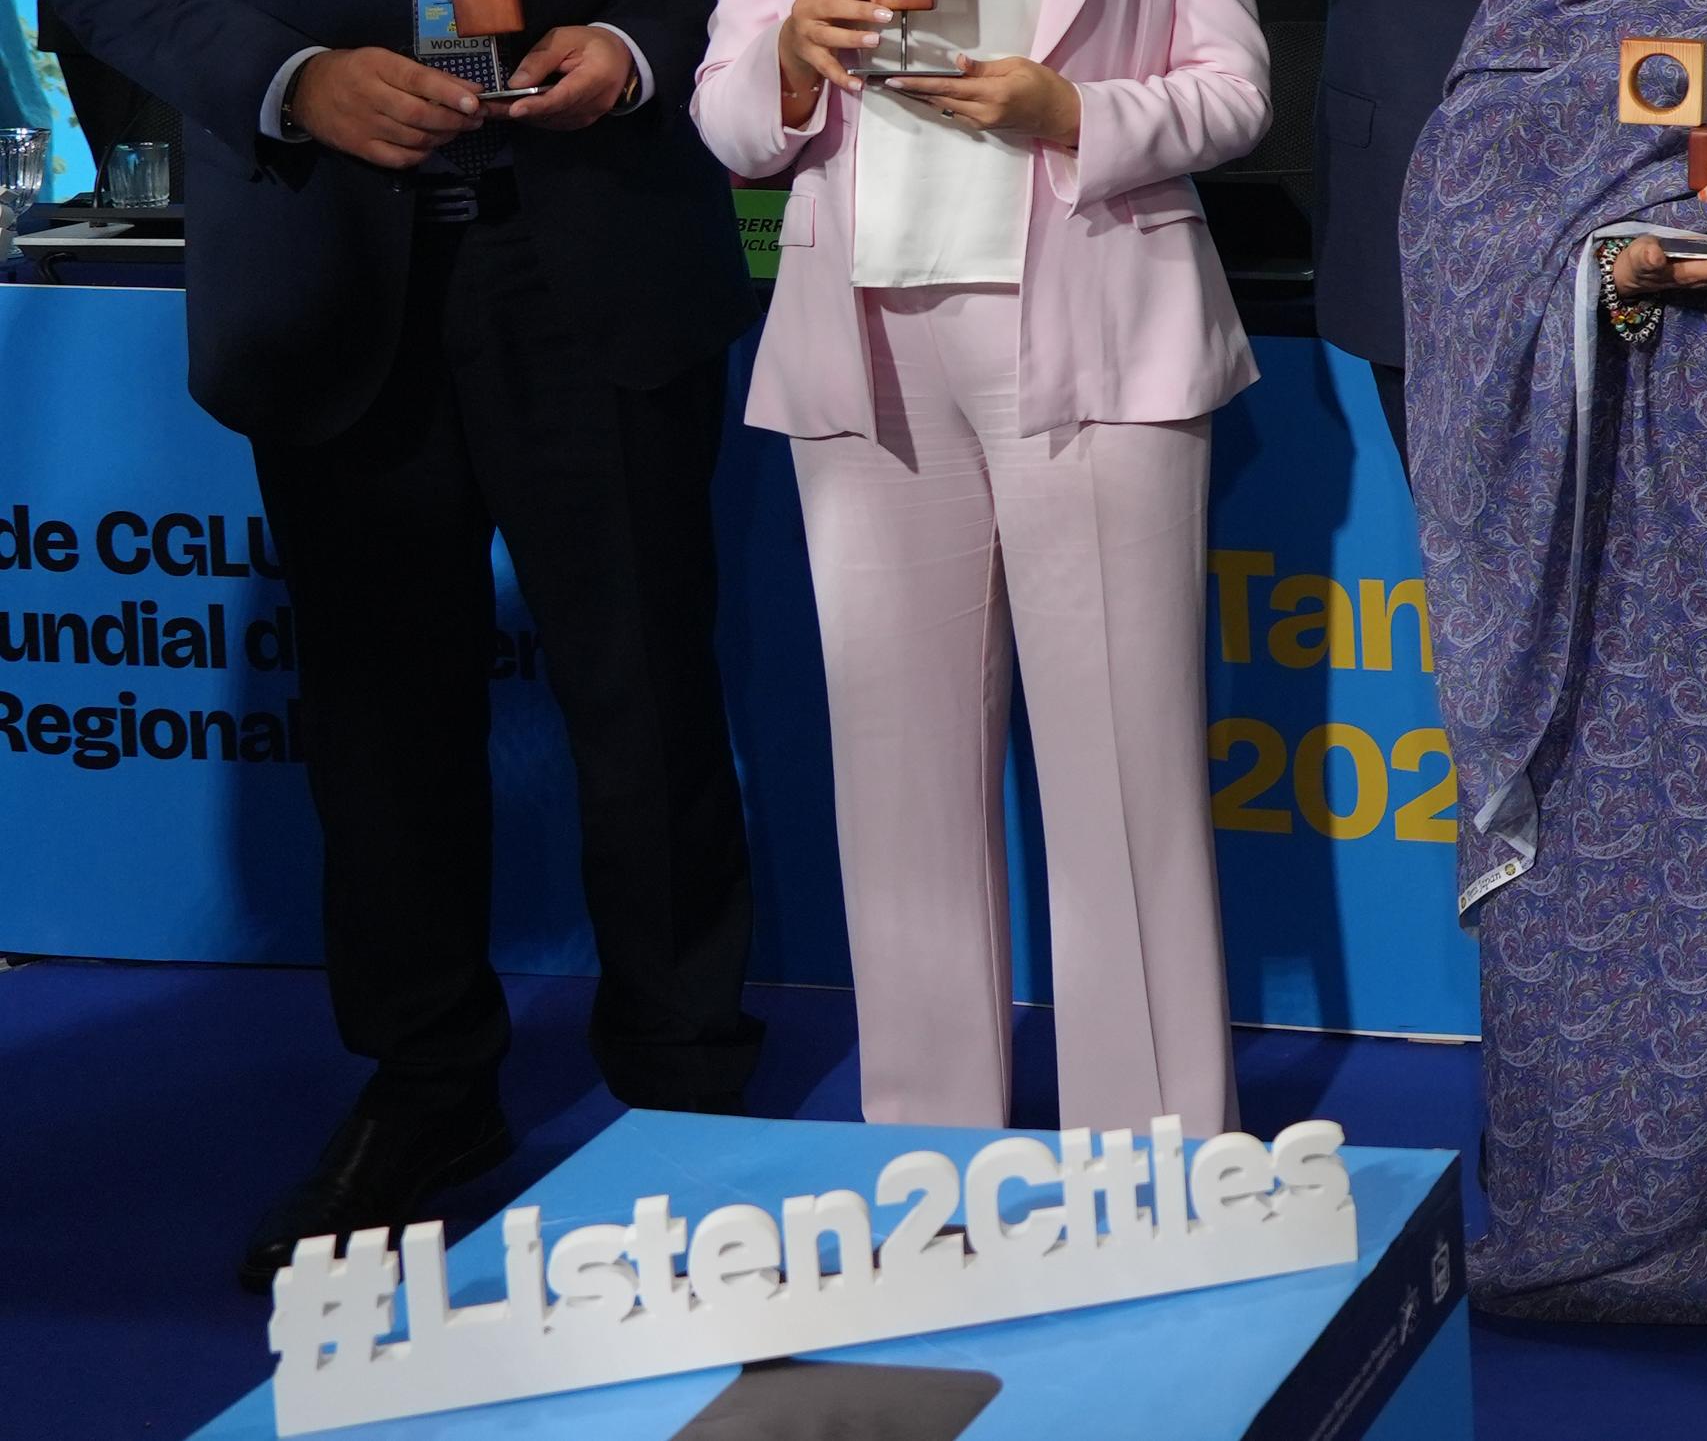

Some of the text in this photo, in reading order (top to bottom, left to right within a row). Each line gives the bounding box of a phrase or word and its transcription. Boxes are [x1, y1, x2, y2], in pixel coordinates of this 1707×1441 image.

[430, 39, 479, 50] WORLD
[0, 505, 80, 573] de
[0, 600, 228, 670] undial
[1207, 717, 1458, 844] 202
[270, 1113, 1356, 1404] #Listen2Cities
